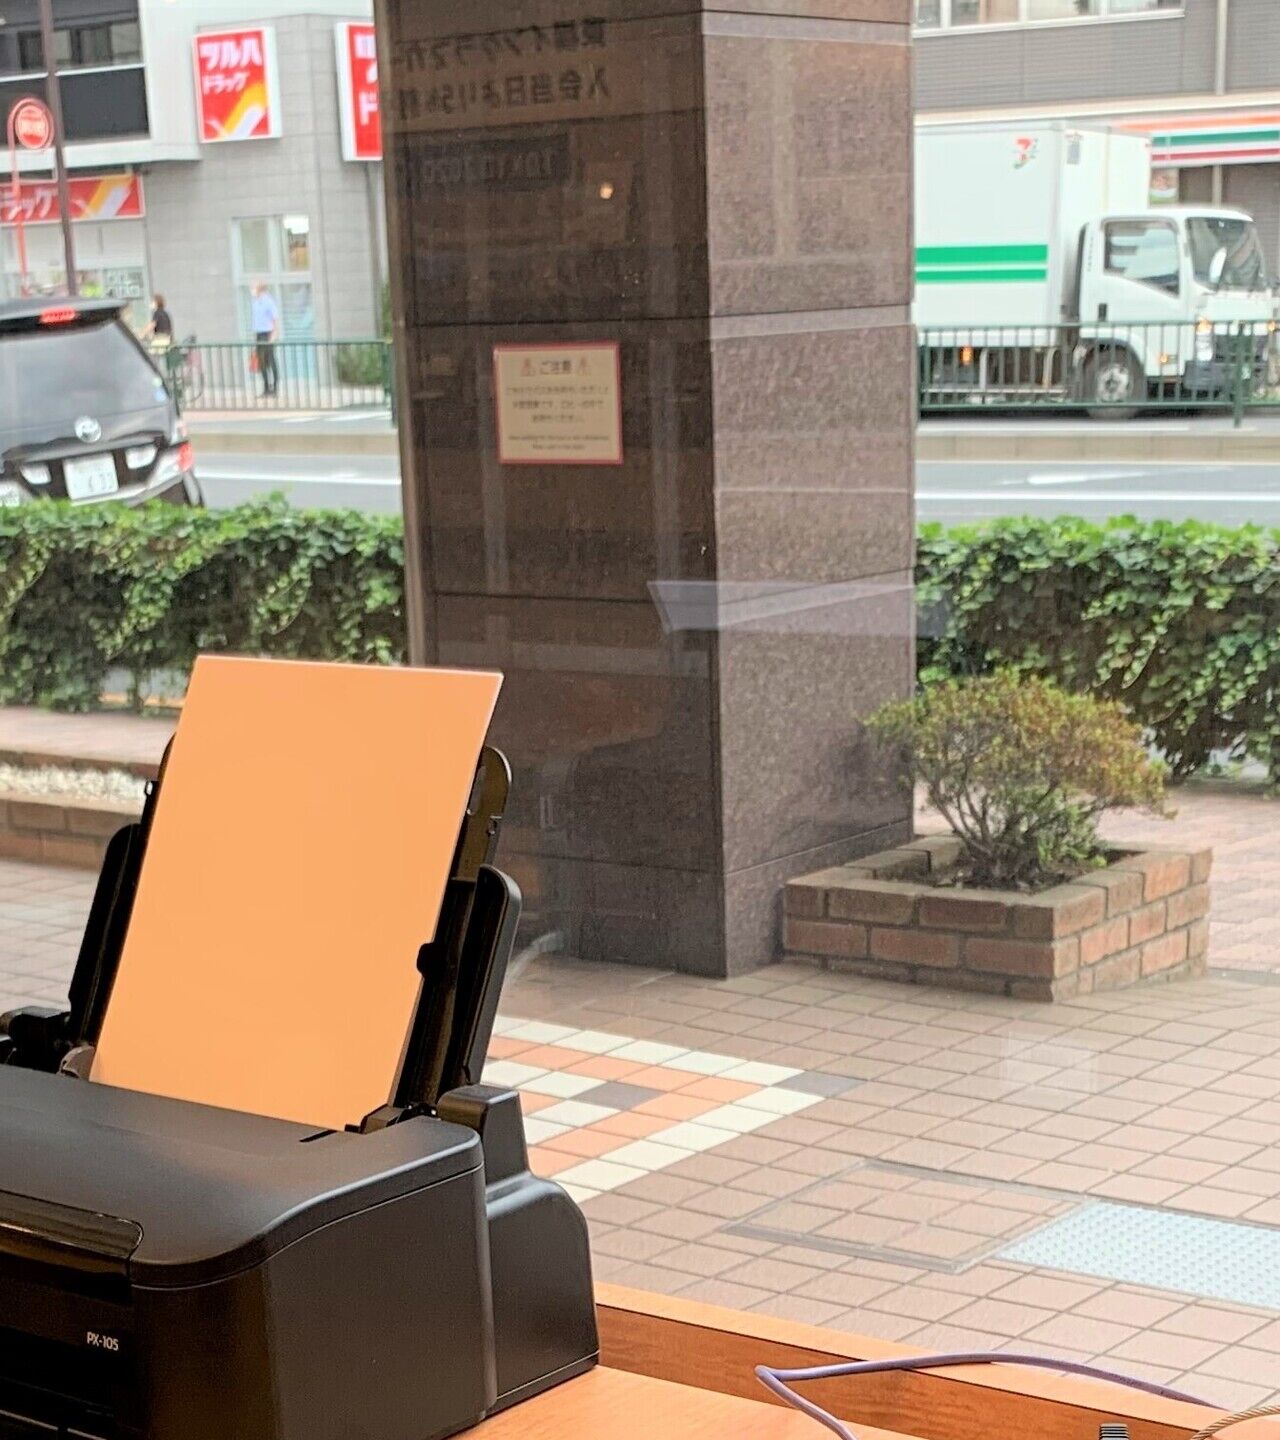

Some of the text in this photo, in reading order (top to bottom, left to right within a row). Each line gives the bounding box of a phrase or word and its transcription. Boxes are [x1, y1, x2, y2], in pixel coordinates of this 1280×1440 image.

[198, 37, 263, 70] ツルハ
[201, 71, 250, 95] ドラッグ
[86, 1330, 120, 1351] PX-105
